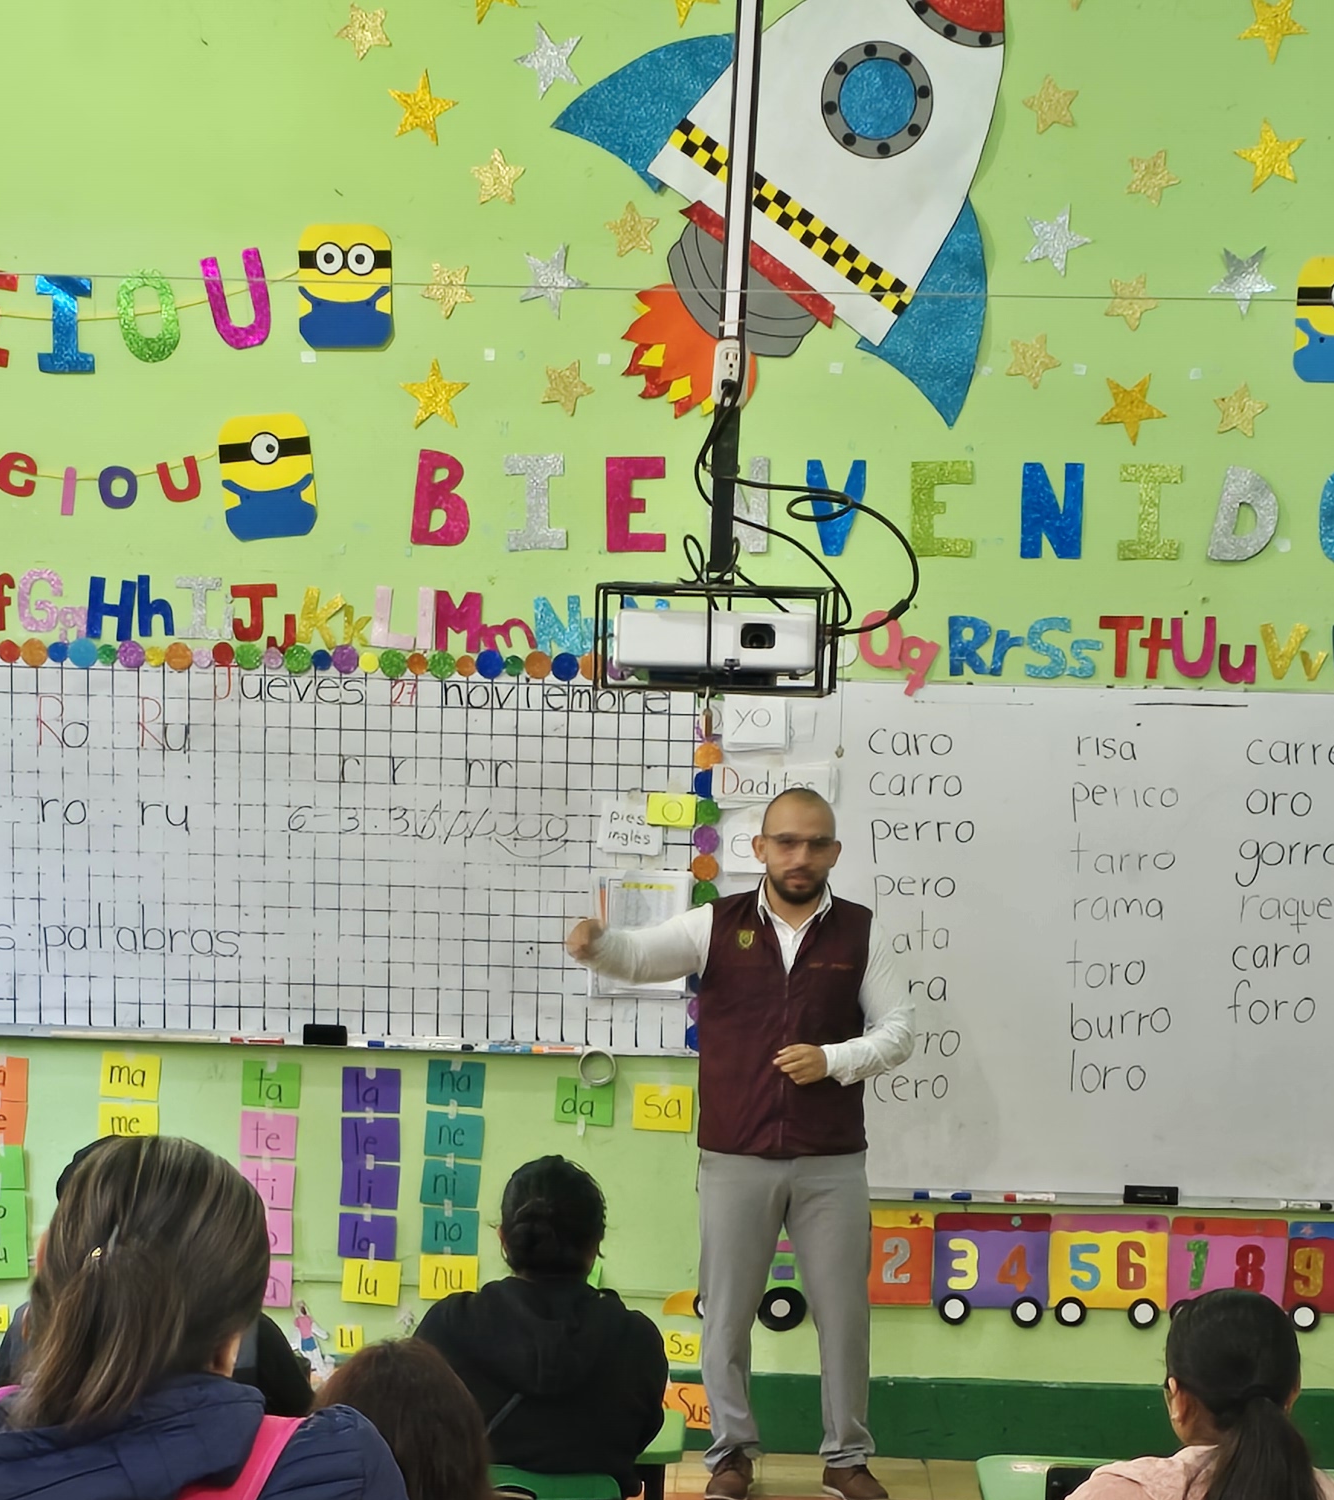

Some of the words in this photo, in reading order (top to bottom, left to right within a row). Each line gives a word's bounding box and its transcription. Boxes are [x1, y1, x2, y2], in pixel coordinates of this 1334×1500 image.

[214, 664, 366, 706] Jueves
[390, 680, 417, 707] 27
[38, 691, 88, 748] Ro
[138, 695, 189, 752] Ru
[732, 708, 771, 736] yo
[868, 727, 954, 757] caro
[1076, 735, 1137, 761] risa
[869, 771, 962, 797] carro
[1072, 781, 1179, 822] perico
[1246, 789, 1312, 817] oro
[41, 796, 88, 826] ro
[140, 799, 189, 832] ru
[870, 817, 975, 864] perro
[1070, 832, 1176, 875] tarro
[873, 874, 956, 919] pero
[1074, 897, 1164, 922] rama
[43, 902, 241, 972] palabras
[1067, 940, 1146, 988] toro
[1232, 942, 1310, 972] cara
[1070, 1003, 1171, 1042] burro
[1227, 979, 1316, 1025] foro
[109, 1062, 146, 1089] ma
[256, 1071, 283, 1103] ta
[439, 1072, 471, 1094] na
[873, 1072, 948, 1103] cero
[1070, 1049, 1146, 1093] loro
[356, 1073, 379, 1106] la
[561, 1088, 594, 1118] da
[110, 1113, 141, 1136] me
[252, 1117, 280, 1150] te
[354, 1121, 376, 1155] le
[437, 1125, 465, 1146] ne
[356, 1168, 372, 1204] li
[433, 1171, 456, 1196] ni
[352, 1223, 370, 1252] lo
[434, 1221, 462, 1242] no
[357, 1262, 378, 1297] lu
[433, 1266, 463, 1290] nu
[882, 1237, 911, 1285] 2
[948, 1237, 980, 1291] 3
[998, 1244, 1032, 1293] 4
[1070, 1243, 1101, 1292] 5
[1116, 1240, 1147, 1291] 6
[1186, 1239, 1211, 1290] 7
[1234, 1243, 1266, 1293] 8
[1292, 1247, 1326, 1298] 9
